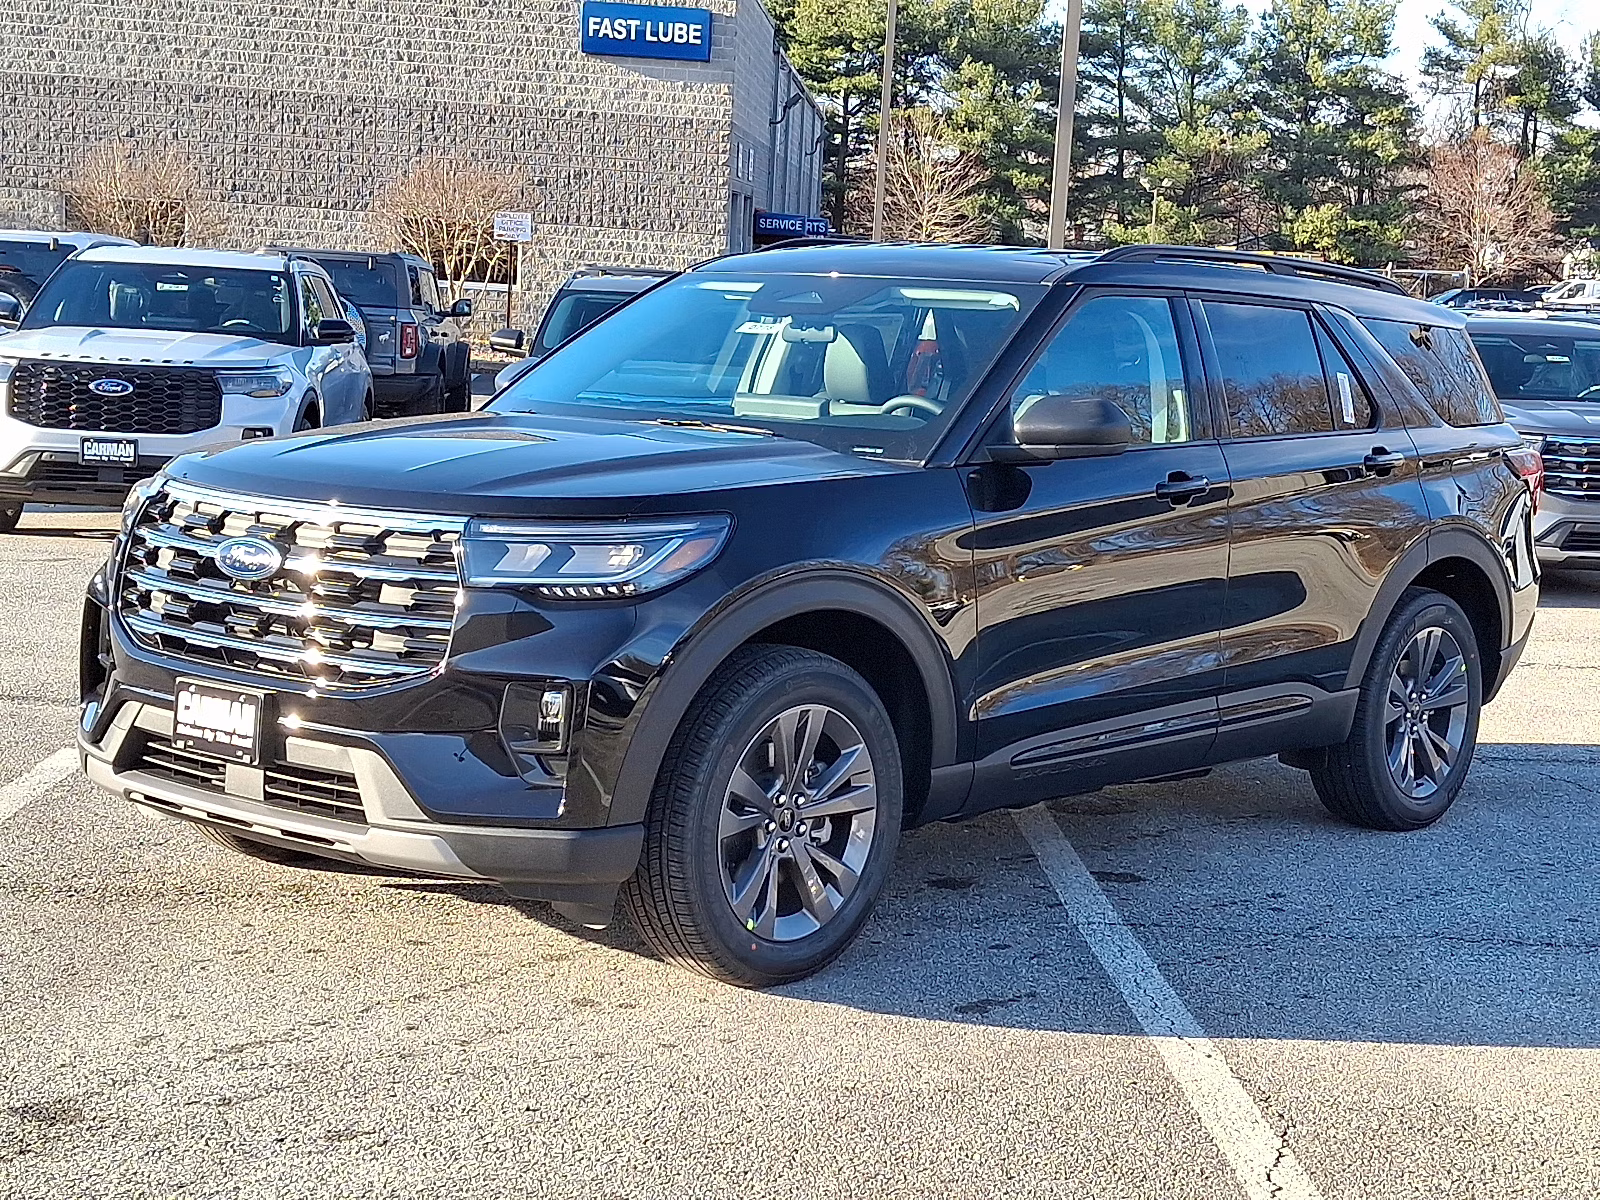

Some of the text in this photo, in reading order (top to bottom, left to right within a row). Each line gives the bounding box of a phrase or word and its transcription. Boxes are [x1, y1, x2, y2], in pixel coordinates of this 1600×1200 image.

[588, 16, 703, 45] FAST LUBE
[759, 218, 803, 231] SERVICE
[806, 221, 826, 233] RTS
[84, 442, 134, 457] CARMAN
